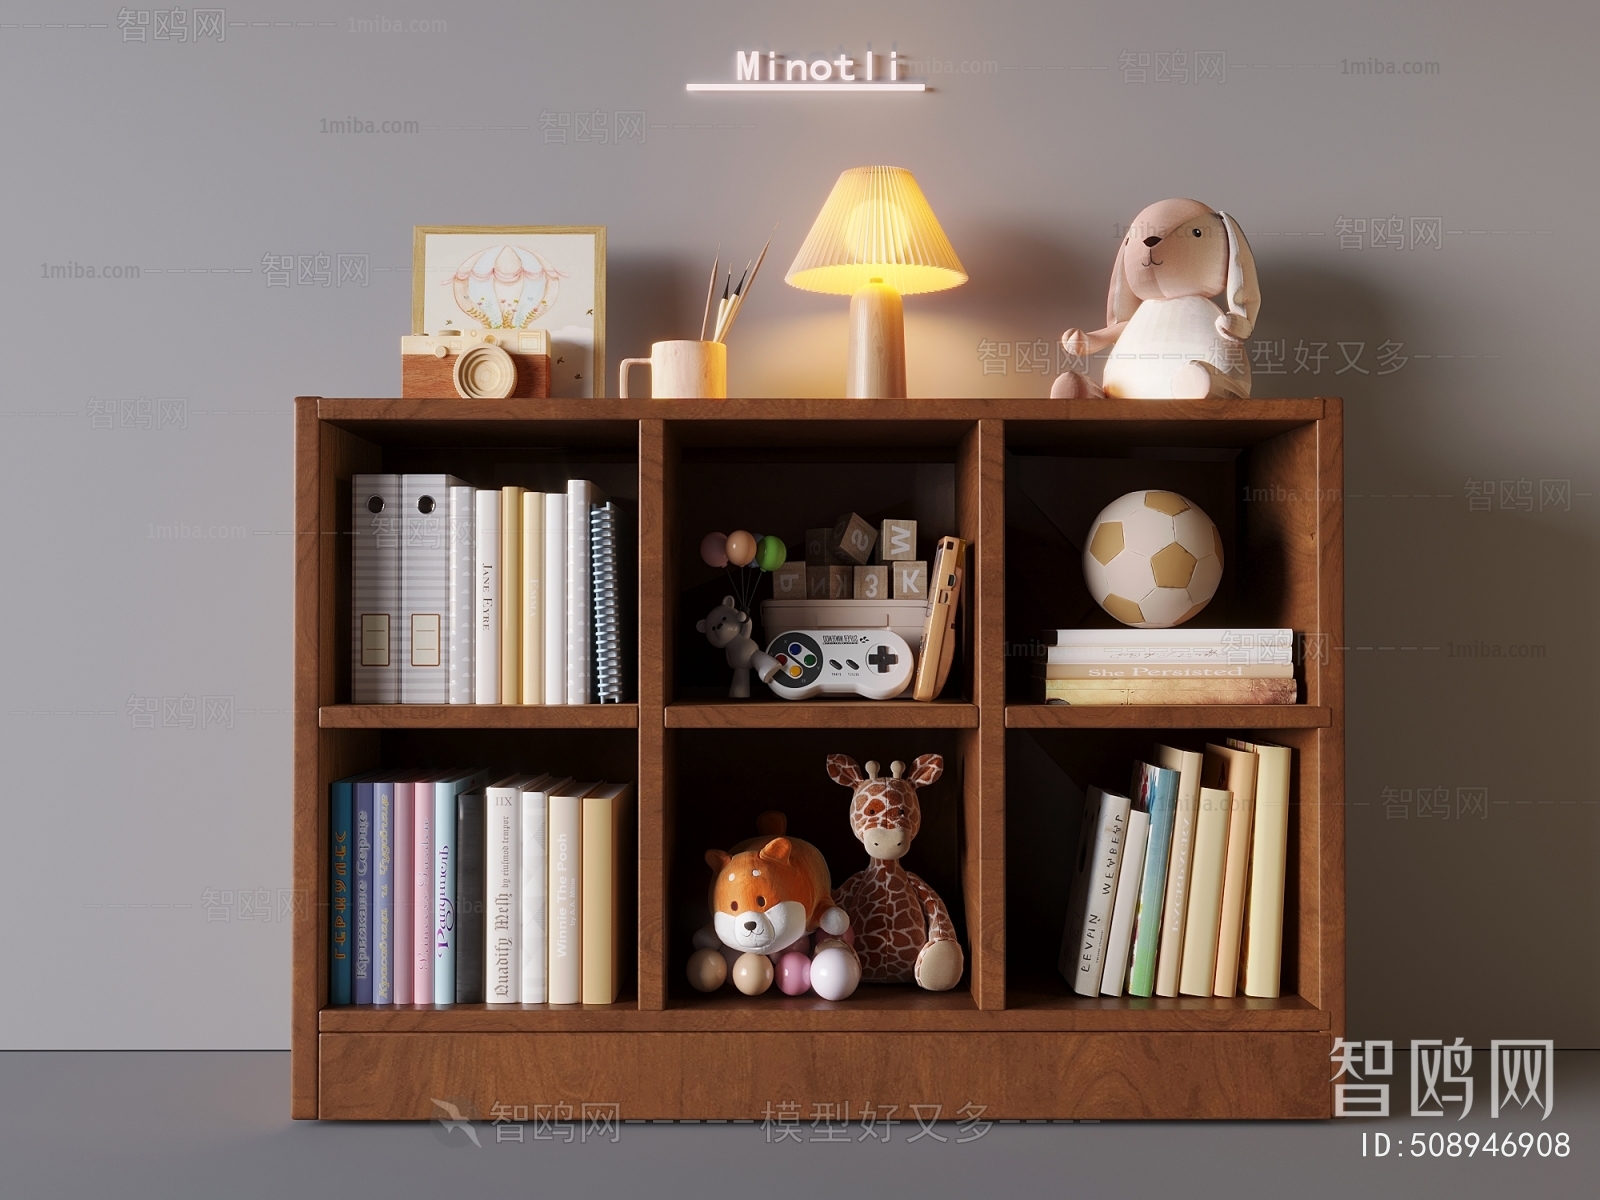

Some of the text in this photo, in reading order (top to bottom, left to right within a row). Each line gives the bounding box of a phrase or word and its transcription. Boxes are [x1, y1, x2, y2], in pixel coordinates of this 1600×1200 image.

[902, 569, 920, 593] K
[1088, 666, 1243, 677] She Persisted
[557, 833, 567, 958] Winnie The Pooh
